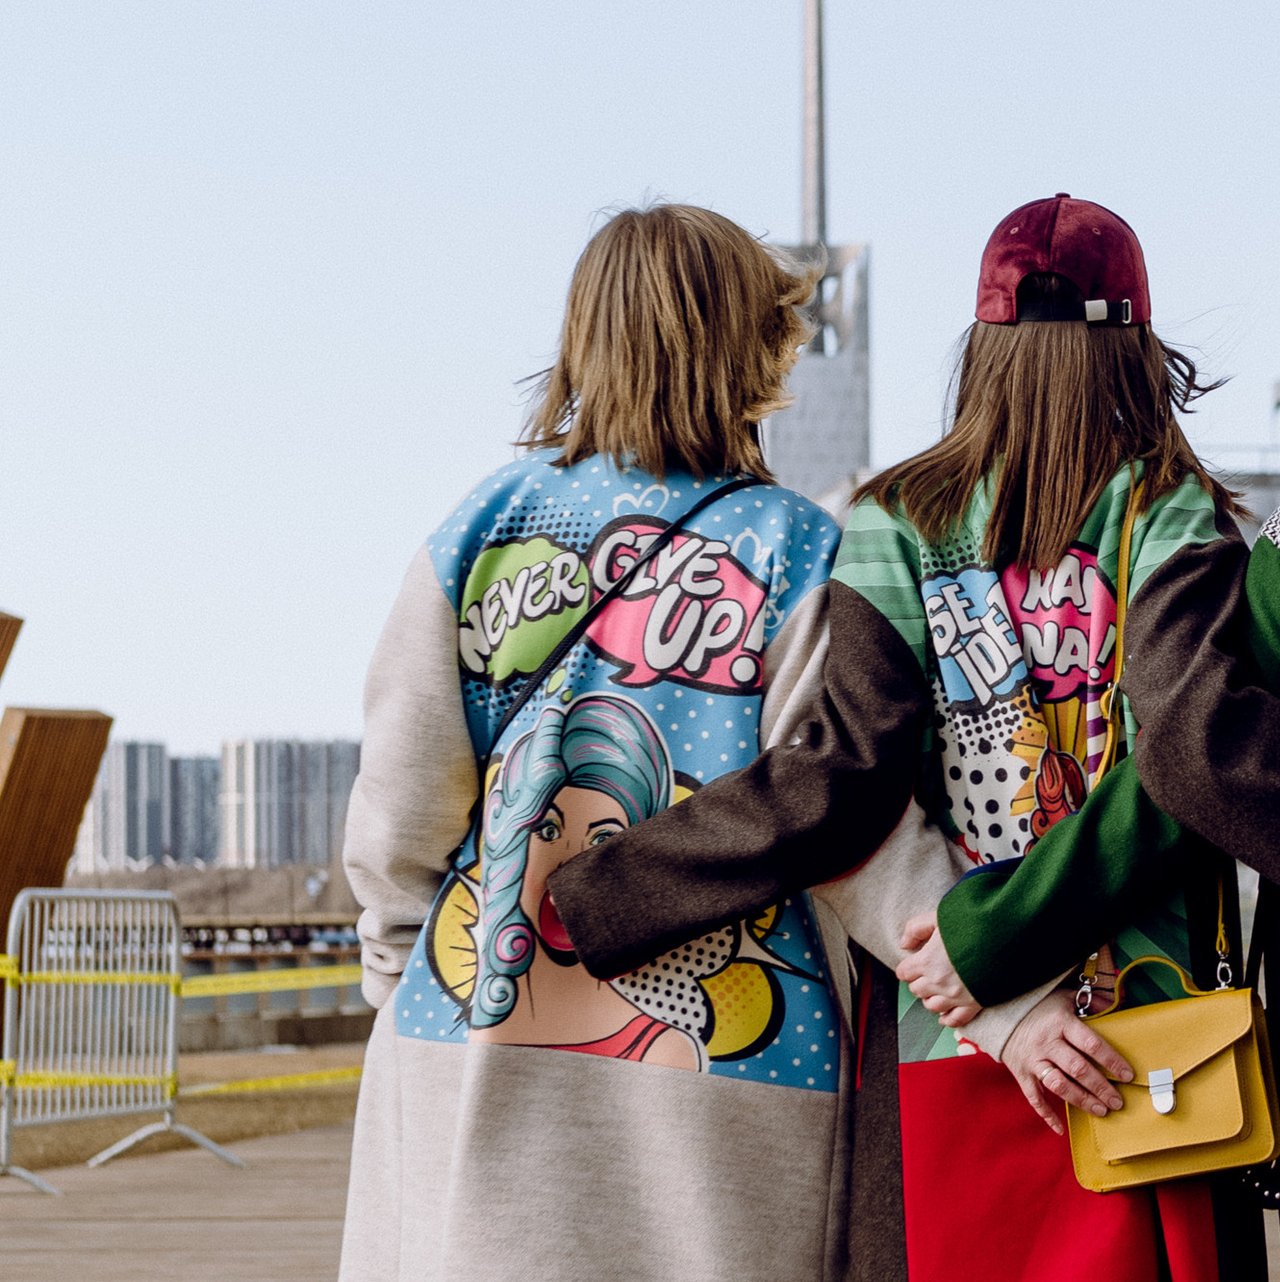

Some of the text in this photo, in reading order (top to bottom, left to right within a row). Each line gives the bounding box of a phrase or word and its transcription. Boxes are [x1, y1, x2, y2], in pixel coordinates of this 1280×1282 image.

[459, 530, 730, 673] NEVER GIVE
[644, 584, 767, 682] UP!
